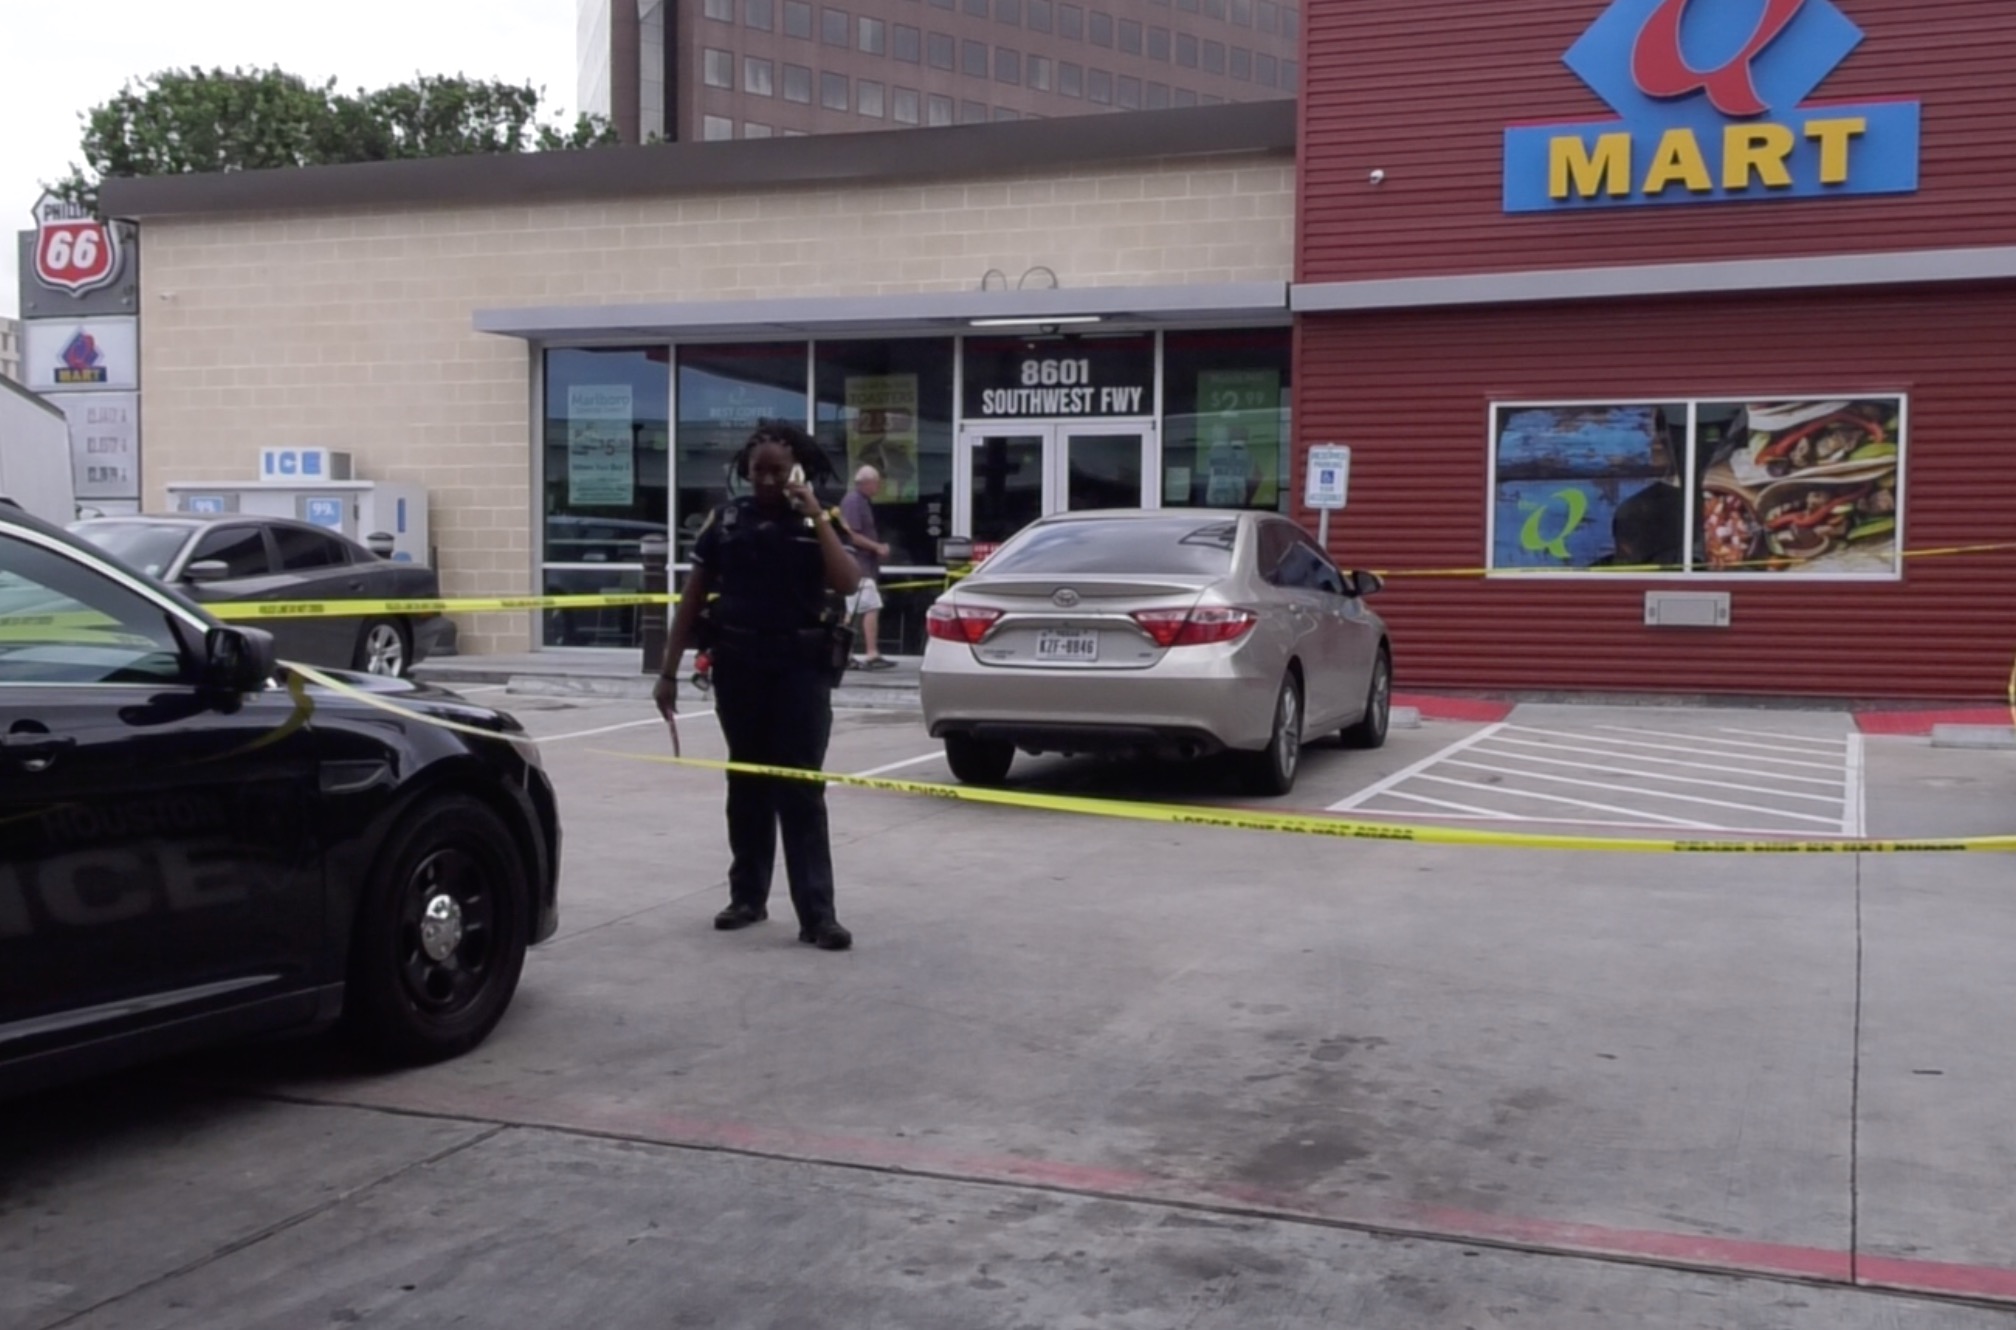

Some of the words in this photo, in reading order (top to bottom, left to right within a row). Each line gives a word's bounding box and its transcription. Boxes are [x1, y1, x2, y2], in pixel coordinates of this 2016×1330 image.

[1548, 116, 1867, 199] MART
[46, 229, 100, 271] 66
[58, 369, 100, 382] MART
[1021, 358, 1090, 386] 8601
[571, 392, 630, 407] Marlboro
[981, 387, 1095, 415] SOUTHWEST
[1100, 386, 1143, 413] FWY
[265, 451, 322, 475] ICE
